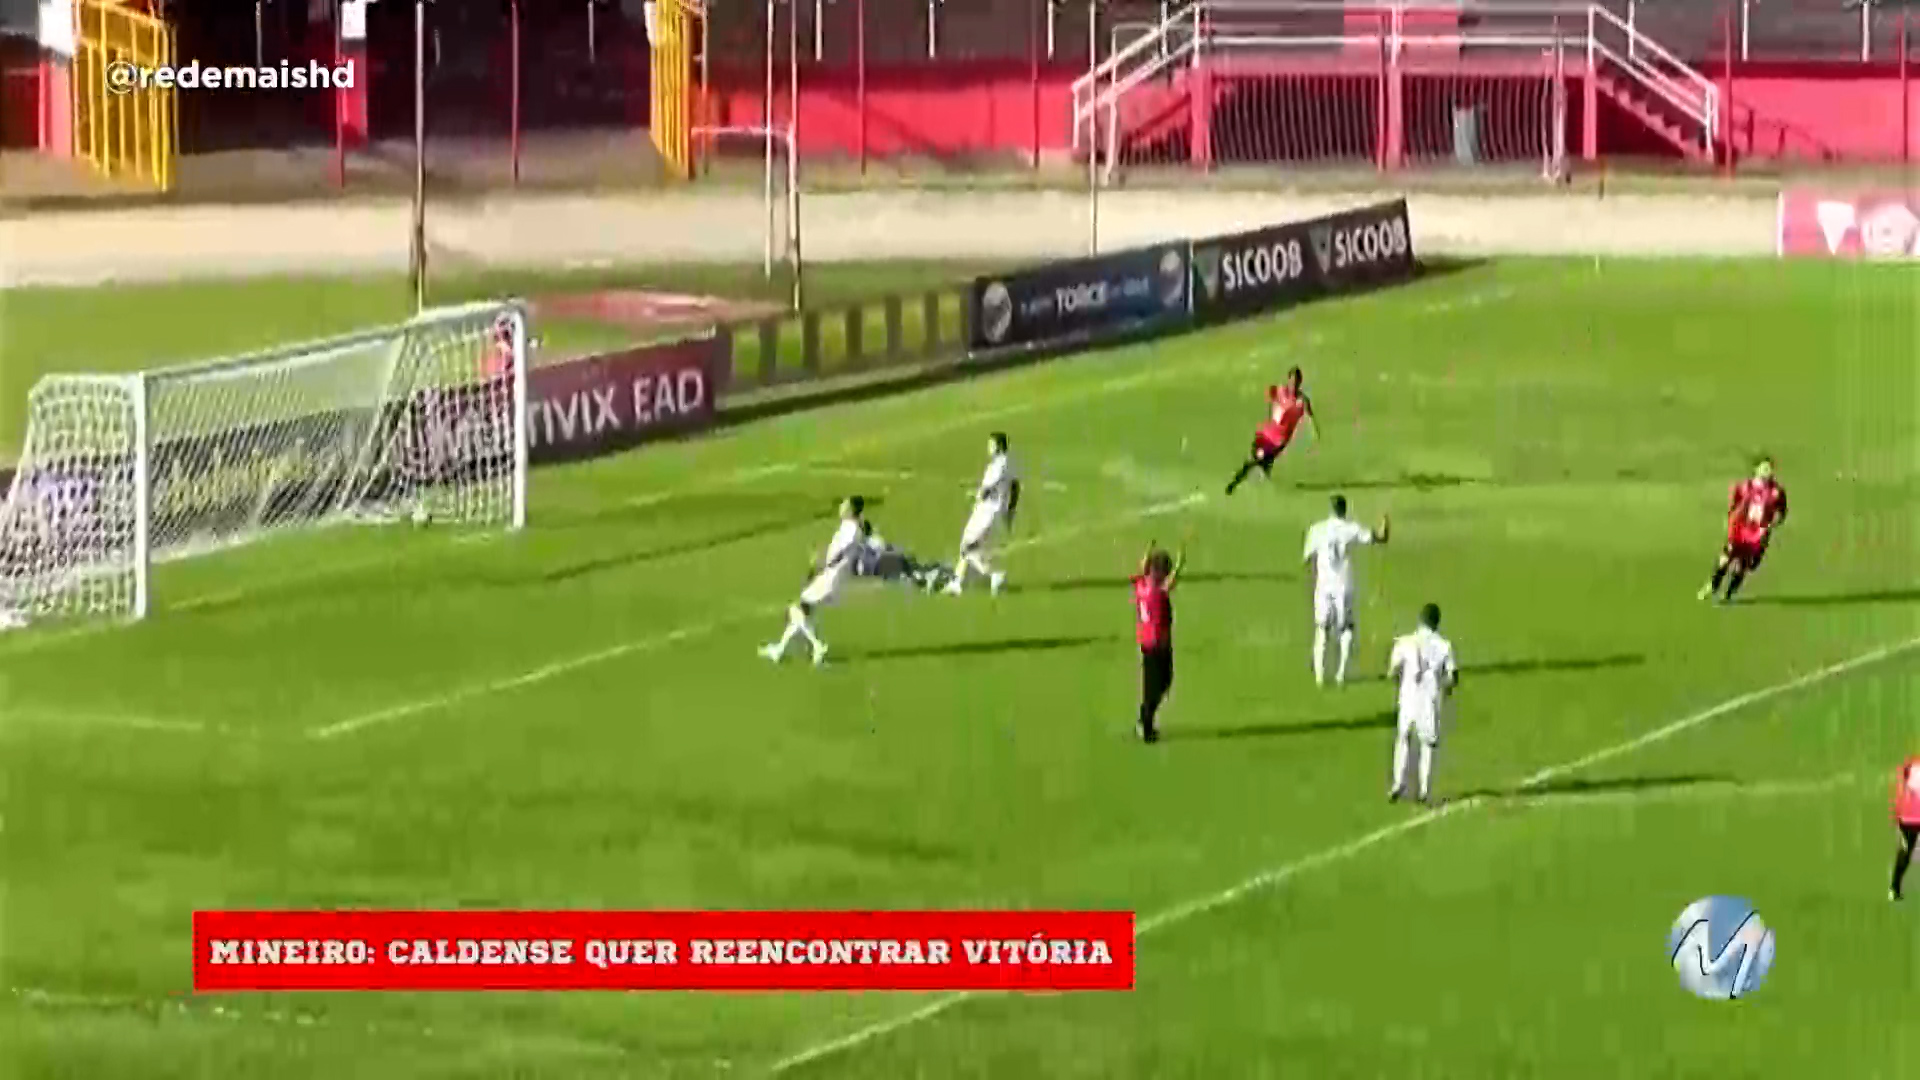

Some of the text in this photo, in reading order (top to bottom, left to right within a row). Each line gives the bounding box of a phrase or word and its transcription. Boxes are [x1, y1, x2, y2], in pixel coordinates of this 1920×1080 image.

[1222, 238, 1304, 291] SICOOB
[1334, 216, 1407, 268] SICOOB
[632, 367, 705, 426] EAD
